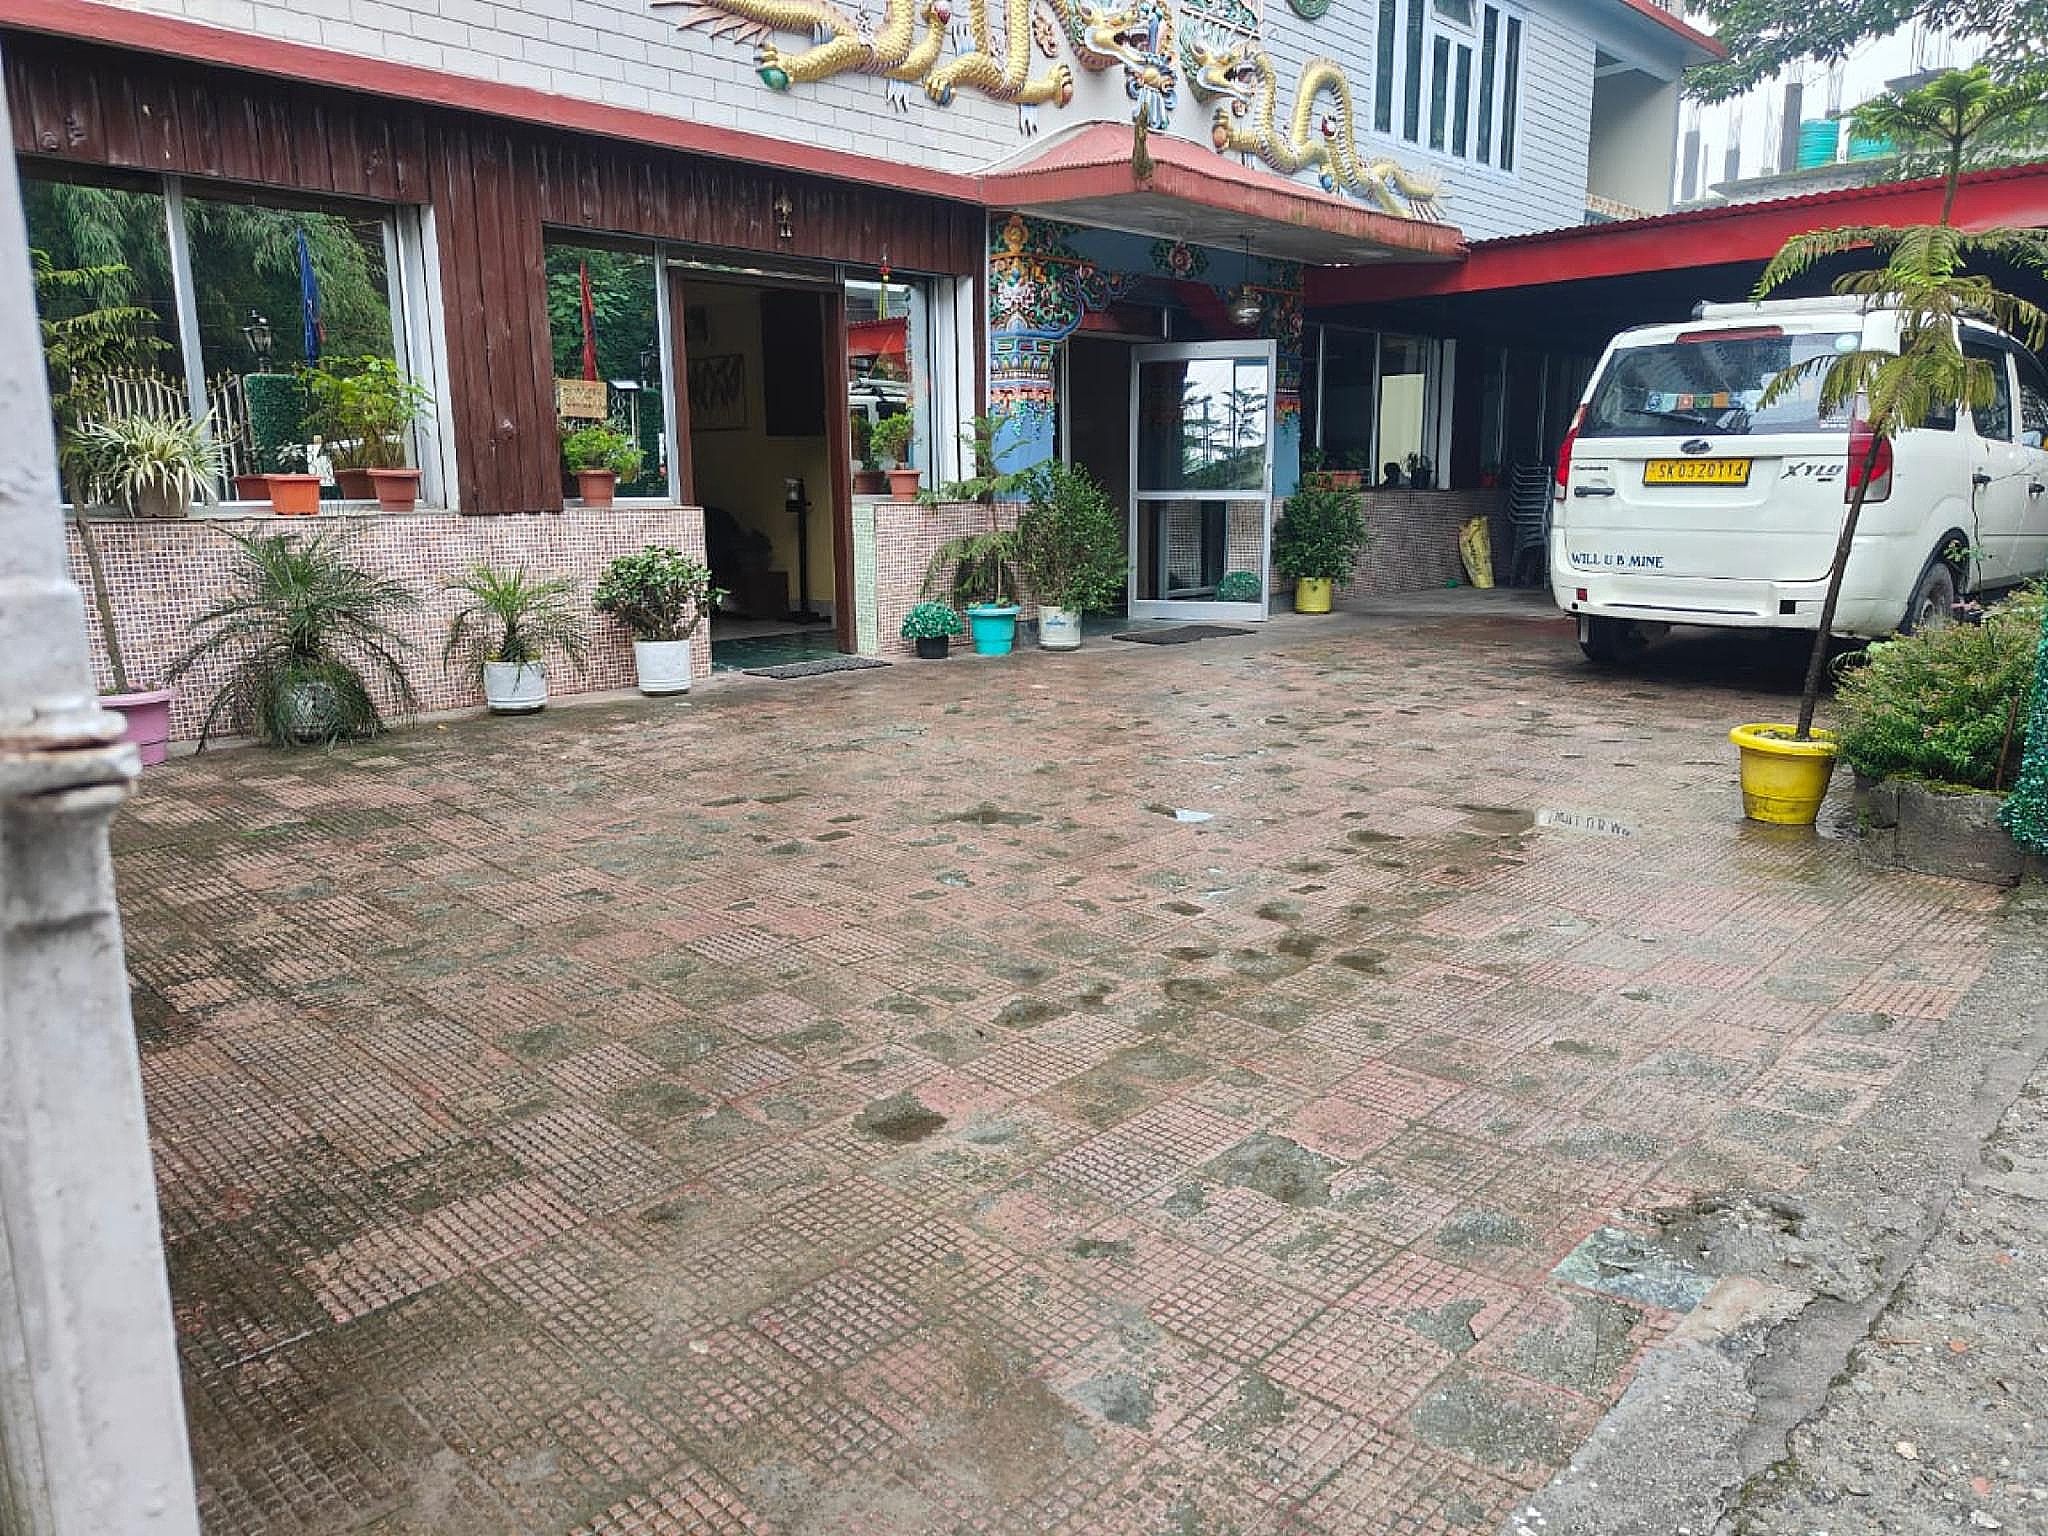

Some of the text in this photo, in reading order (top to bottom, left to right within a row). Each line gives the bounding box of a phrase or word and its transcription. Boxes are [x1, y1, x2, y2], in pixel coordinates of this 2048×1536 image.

[1571, 553, 1665, 569] WILL U B MINE
